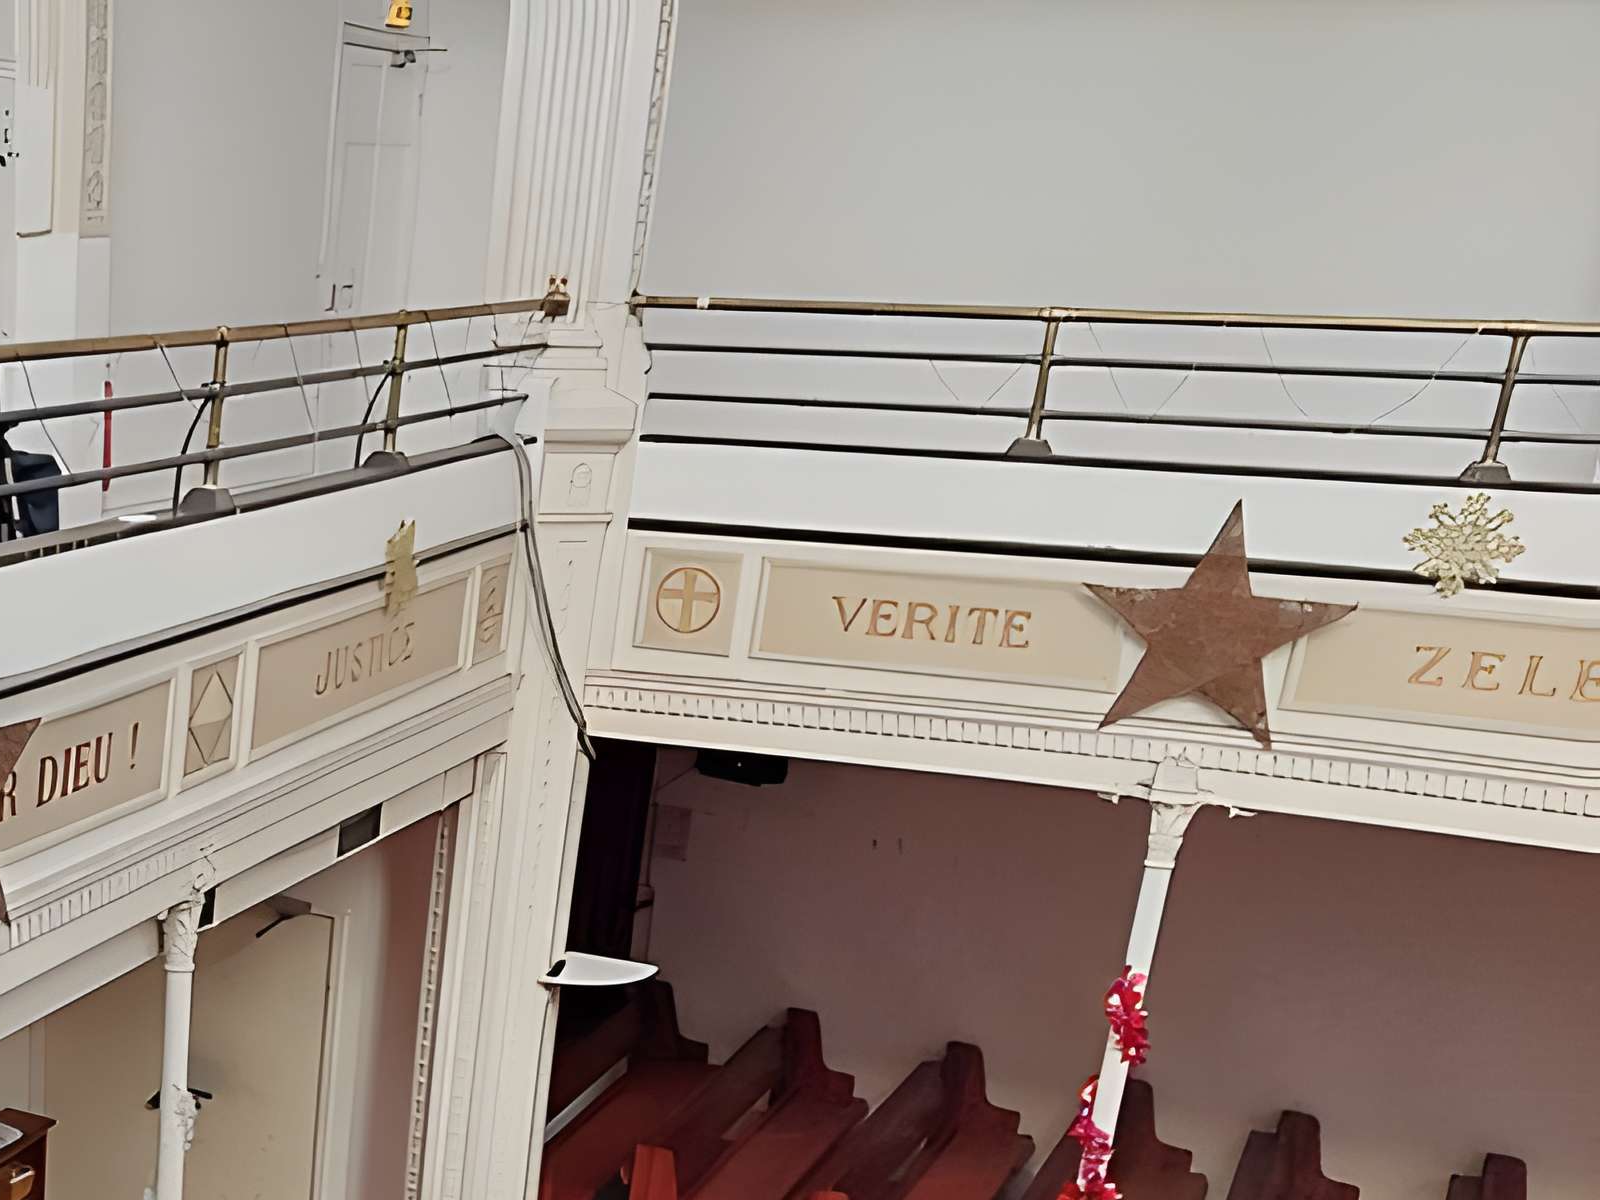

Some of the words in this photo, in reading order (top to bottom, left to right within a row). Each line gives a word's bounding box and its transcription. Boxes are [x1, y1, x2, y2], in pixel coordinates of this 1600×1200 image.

[831, 595, 1033, 649] VERITE
[1407, 645, 1600, 703] ZELE
[36, 732, 113, 808] DIEU
[130, 721, 139, 770] !
